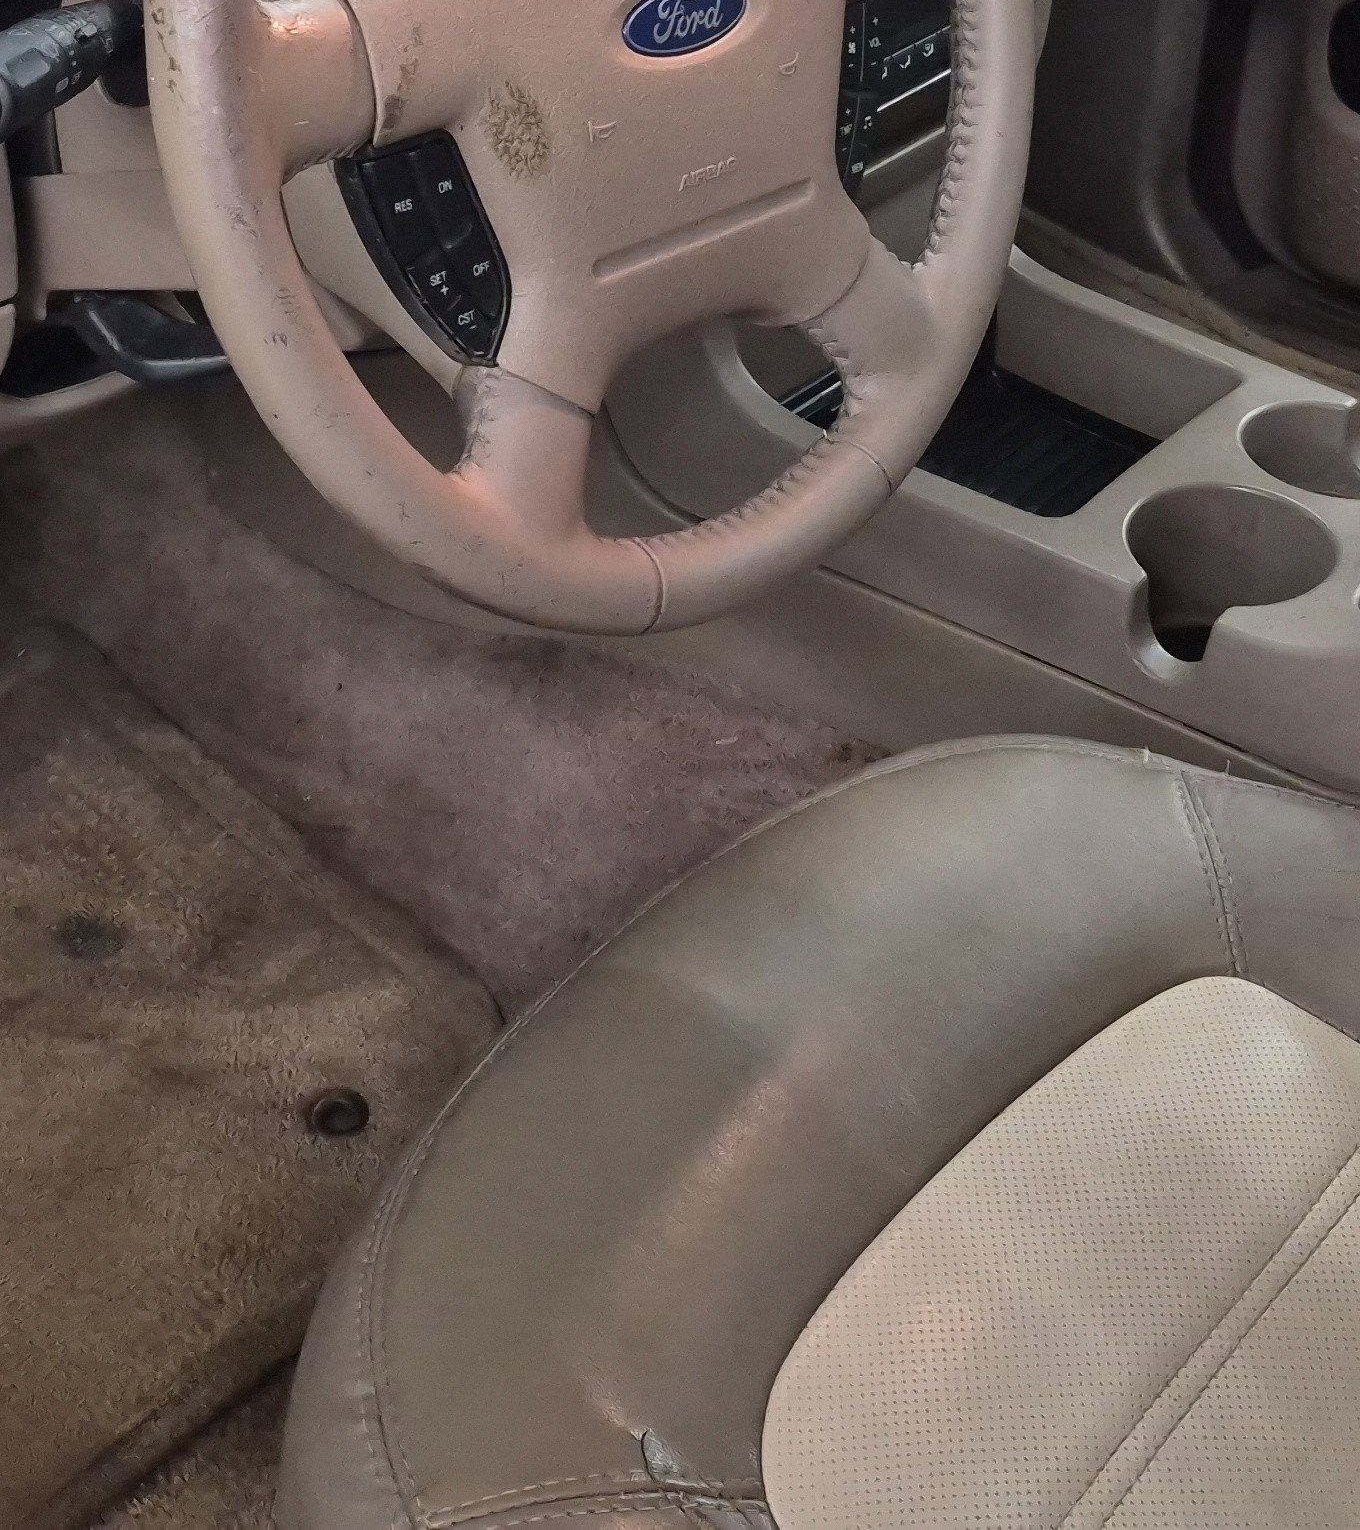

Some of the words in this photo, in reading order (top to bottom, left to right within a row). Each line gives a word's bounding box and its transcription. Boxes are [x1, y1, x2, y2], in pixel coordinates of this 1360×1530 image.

[438, 179, 453, 193] ON
[394, 198, 413, 214] RES
[472, 260, 490, 277] OFF
[430, 271, 447, 287] SET
[458, 310, 475, 326] CST
